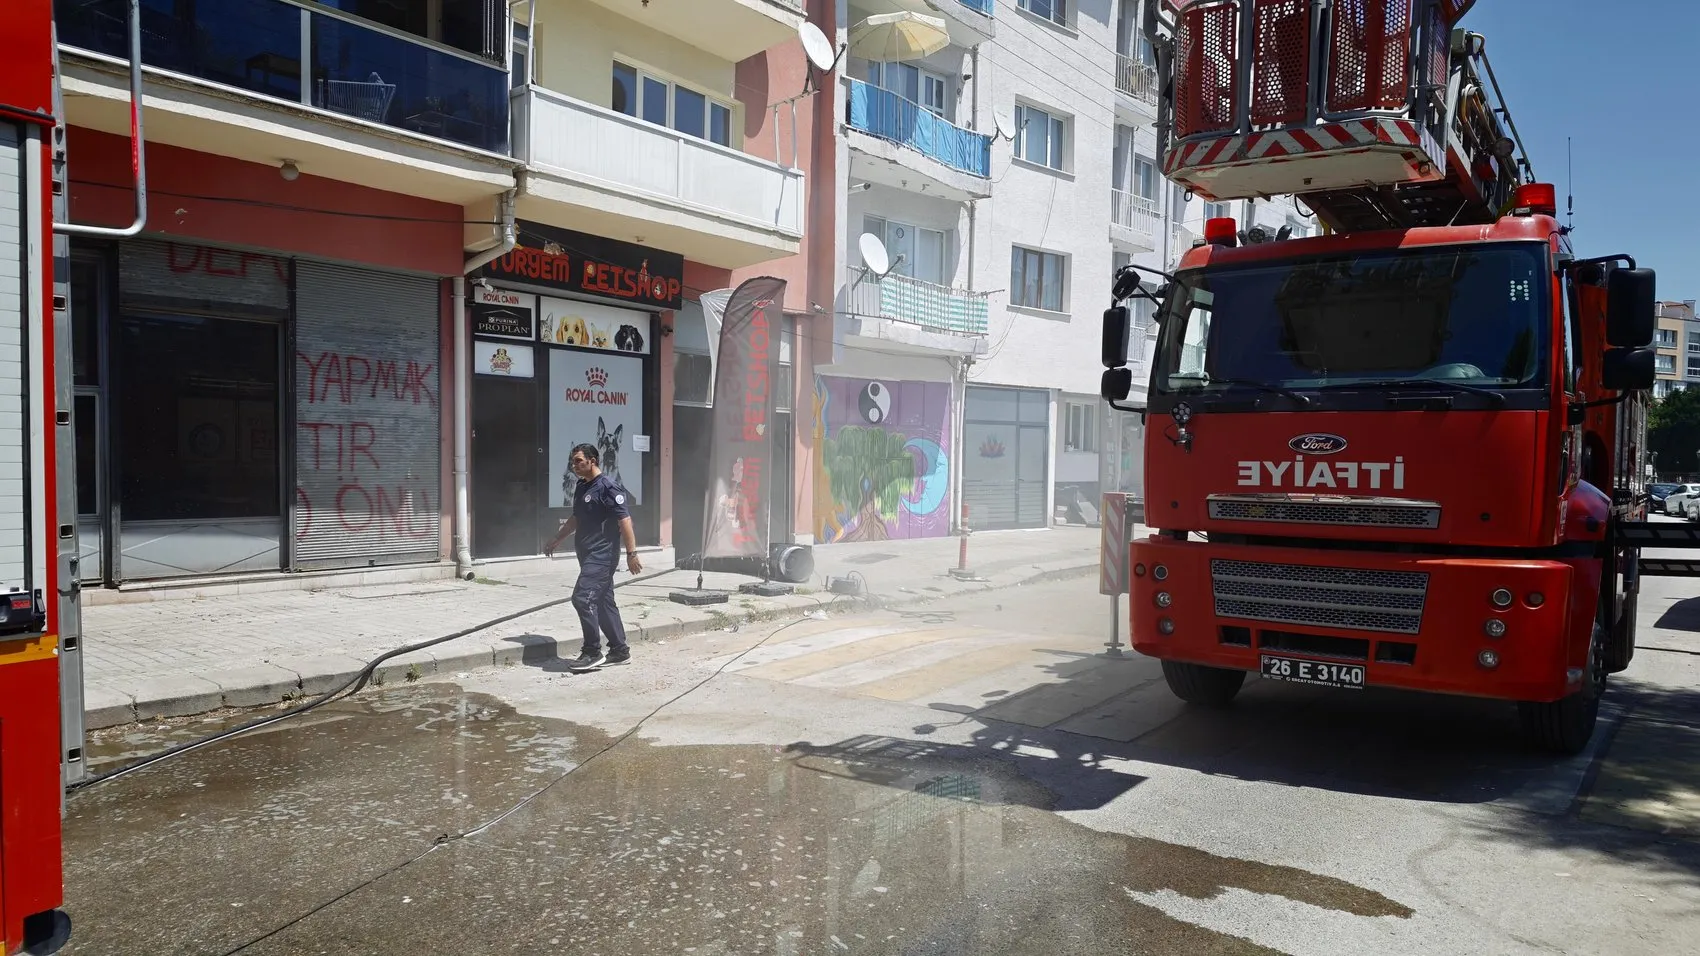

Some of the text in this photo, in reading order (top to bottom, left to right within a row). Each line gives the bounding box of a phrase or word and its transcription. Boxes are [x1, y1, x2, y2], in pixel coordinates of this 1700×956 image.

[581, 260, 681, 302] PETSHOP
[483, 293, 519, 305] ROYAL CANIN
[478, 323, 529, 334] PRO PLAN
[296, 352, 437, 409] YAPMAK
[566, 388, 627, 406] ROYAL CANIN
[1301, 436, 1333, 450] Ford
[1270, 658, 1362, 684] 26 E 3140
